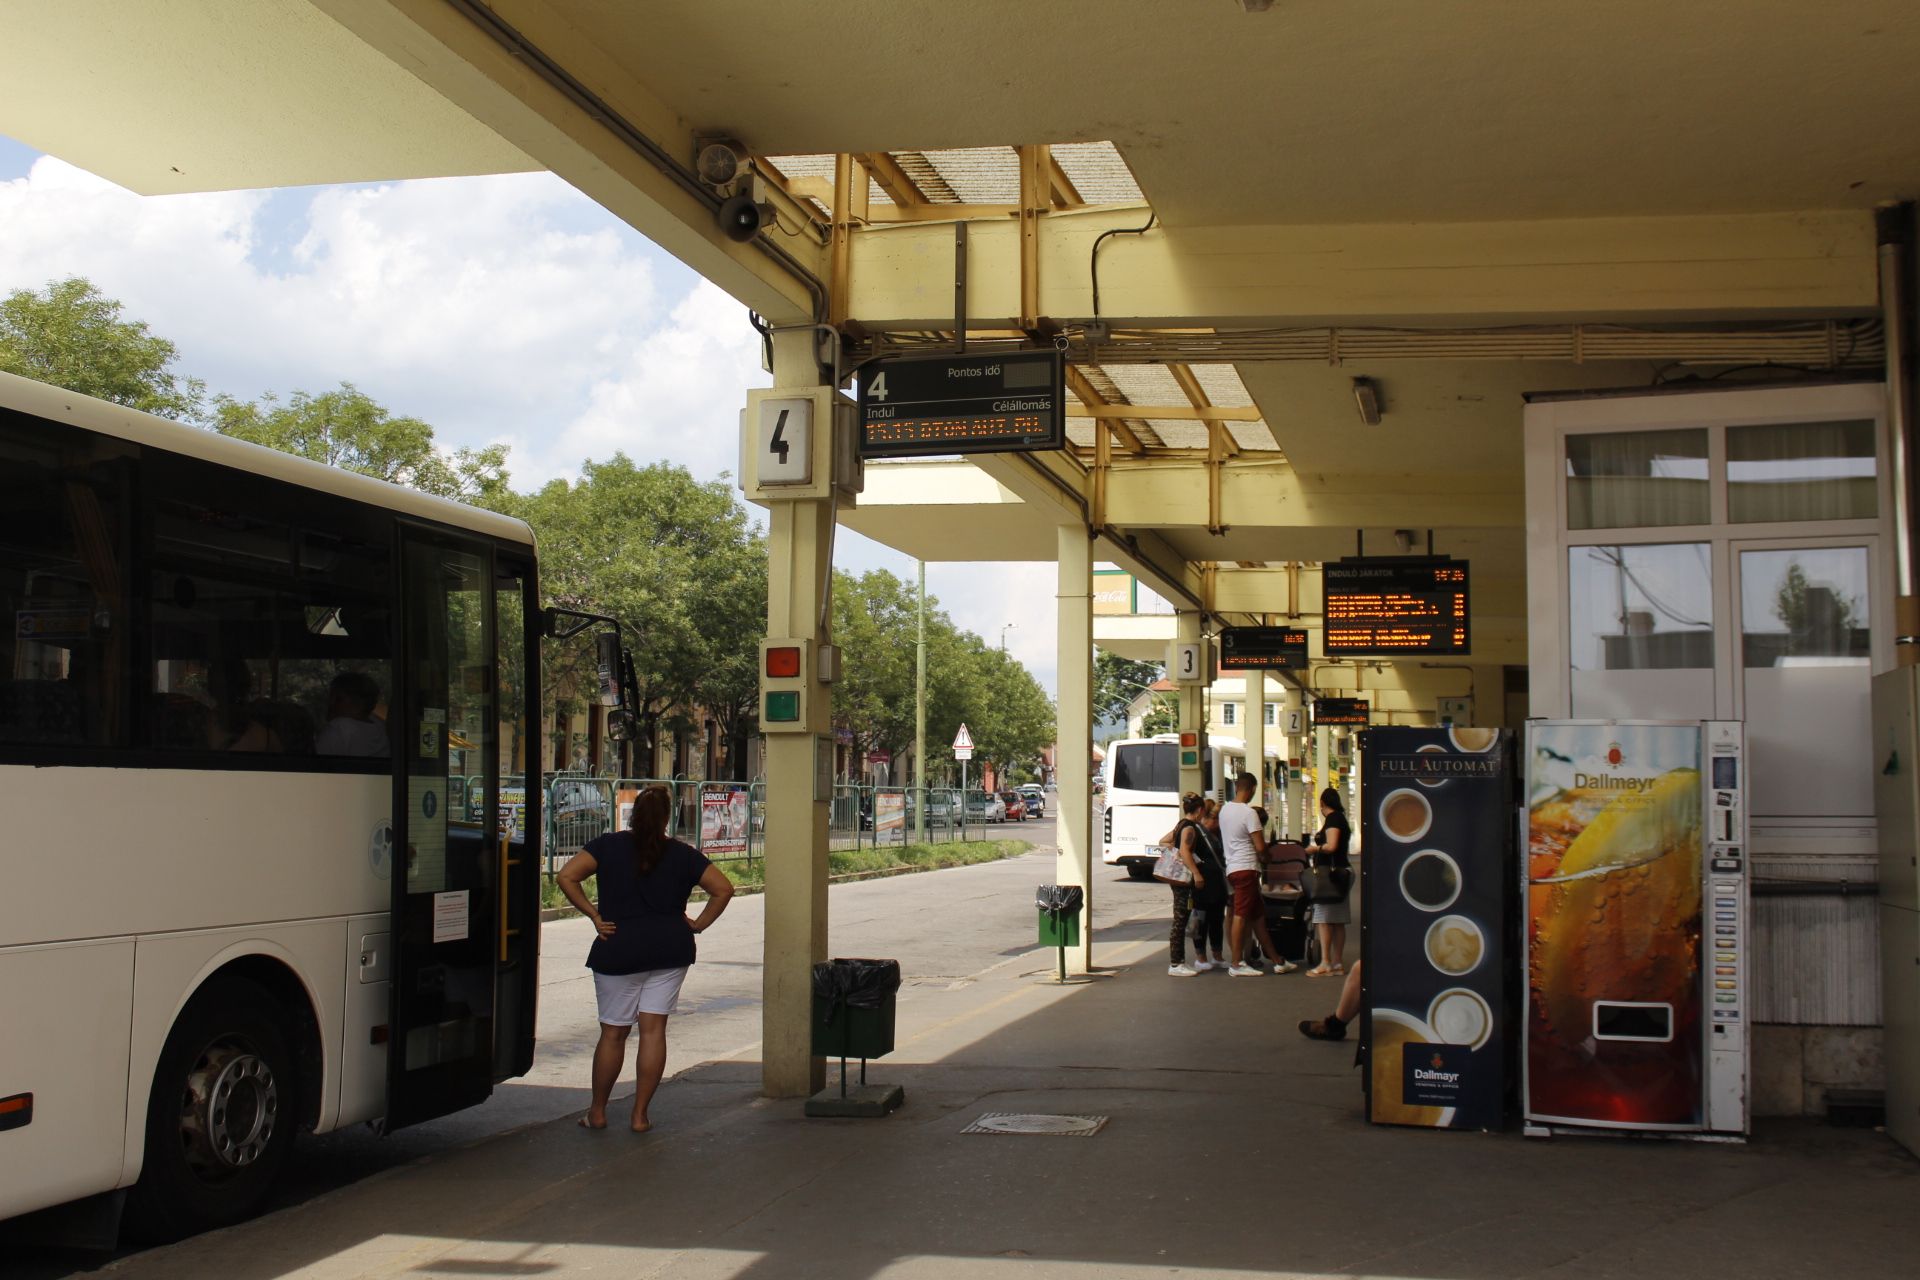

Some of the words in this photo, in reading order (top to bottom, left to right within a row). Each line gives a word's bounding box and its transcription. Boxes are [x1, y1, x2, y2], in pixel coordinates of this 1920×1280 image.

[948, 367, 982, 378] Pontos
[985, 364, 1001, 376] idő
[867, 371, 888, 401] 4
[867, 407, 895, 419] Indul
[993, 399, 1051, 412] Célállomás
[769, 409, 790, 465] 4
[1225, 635, 1234, 648] 3
[1183, 649, 1193, 673] 3
[1291, 714, 1298, 729] 2
[1380, 760, 1418, 771] FULL
[1422, 758, 1497, 772] AUTOMAT
[1575, 773, 1656, 793] Dallmayr
[1414, 1068, 1460, 1083] Dallmayr
